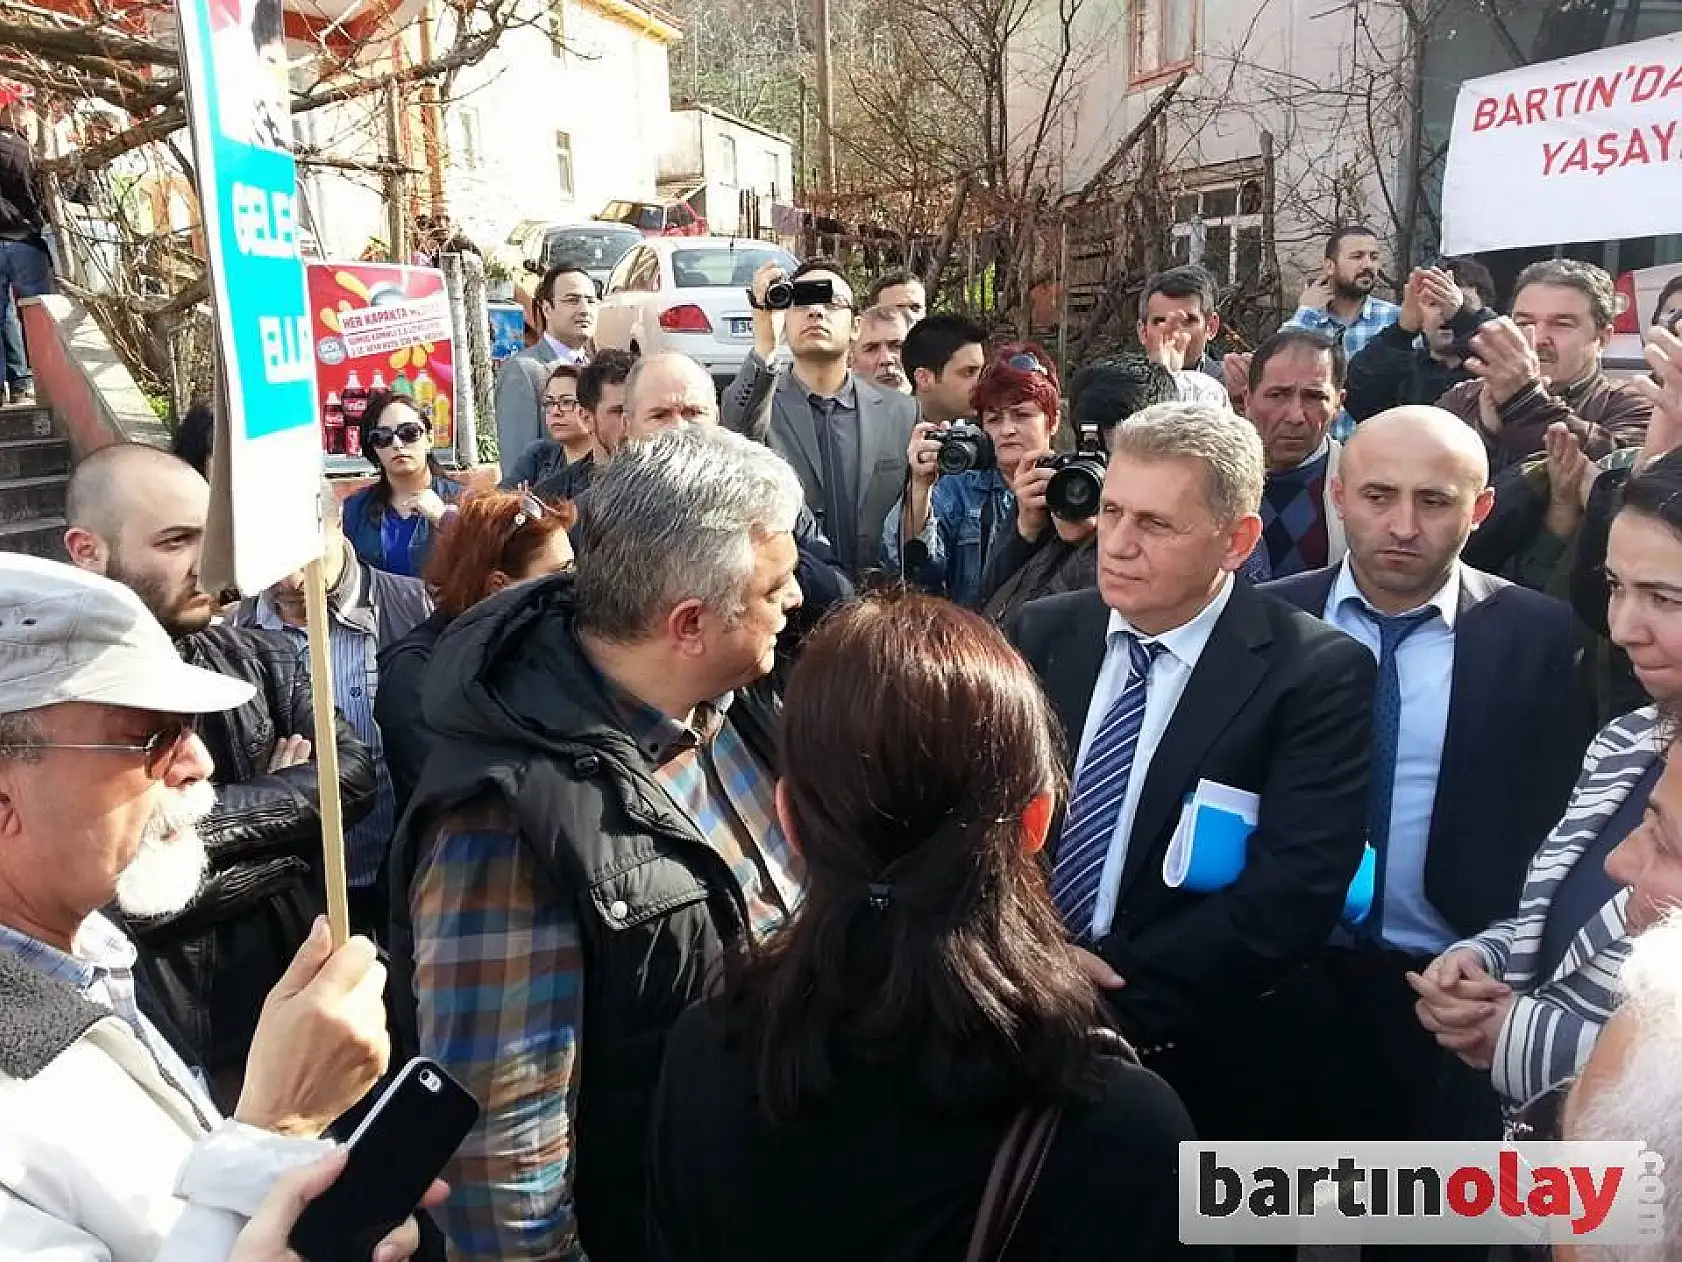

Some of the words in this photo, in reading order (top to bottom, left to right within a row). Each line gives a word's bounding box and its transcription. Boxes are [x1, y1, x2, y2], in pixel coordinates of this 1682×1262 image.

[1472, 64, 1682, 132] BARTIN'DA
[1541, 120, 1682, 176] YAŞAY
[233, 181, 299, 258] GELE
